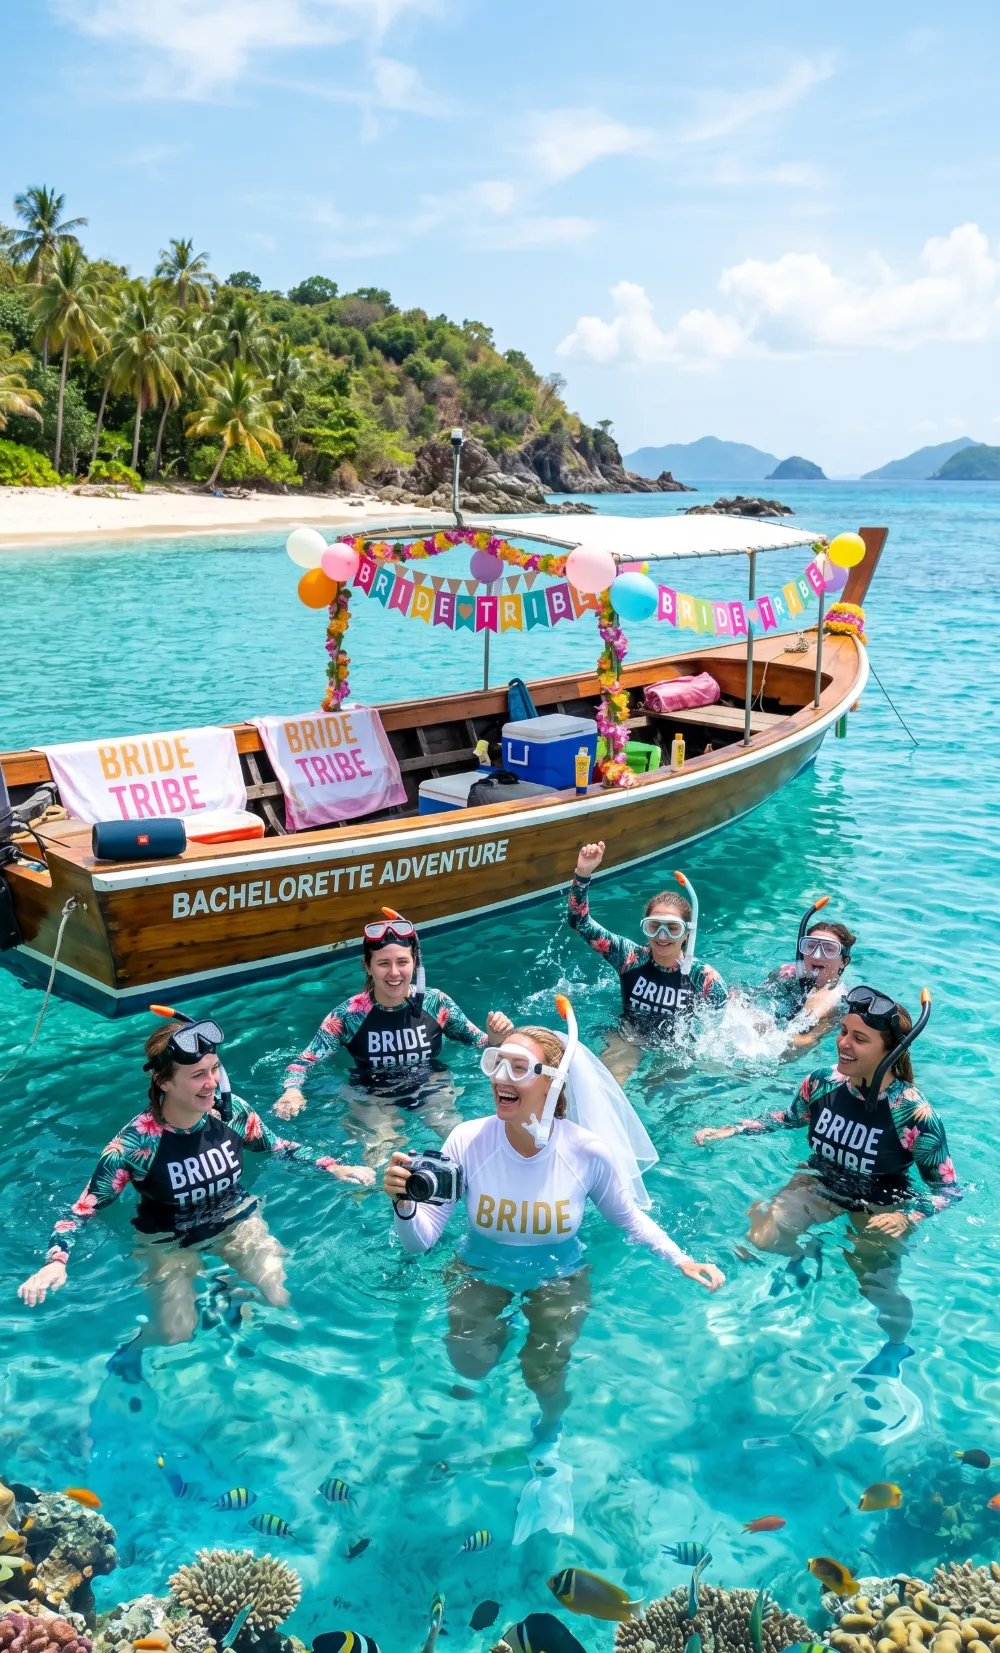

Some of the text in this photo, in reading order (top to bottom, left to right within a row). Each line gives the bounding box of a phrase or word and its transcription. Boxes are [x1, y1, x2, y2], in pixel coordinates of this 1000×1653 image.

[359, 563, 451, 618] BRIDE
[662, 569, 821, 627] BRIDE TRIBE
[283, 714, 358, 753] BRIDE
[97, 736, 195, 780] BRIDE
[295, 748, 373, 788] TRIBE
[108, 775, 207, 820] TRIBE
[172, 839, 510, 919] BACHELORETTE ADVENTURE
[631, 975, 687, 1009] BRIDE
[367, 1024, 431, 1053] BRIDE
[814, 1107, 884, 1156] BRIDE
[167, 1139, 239, 1190] BRIDE
[476, 1193, 572, 1235] BRIDE
